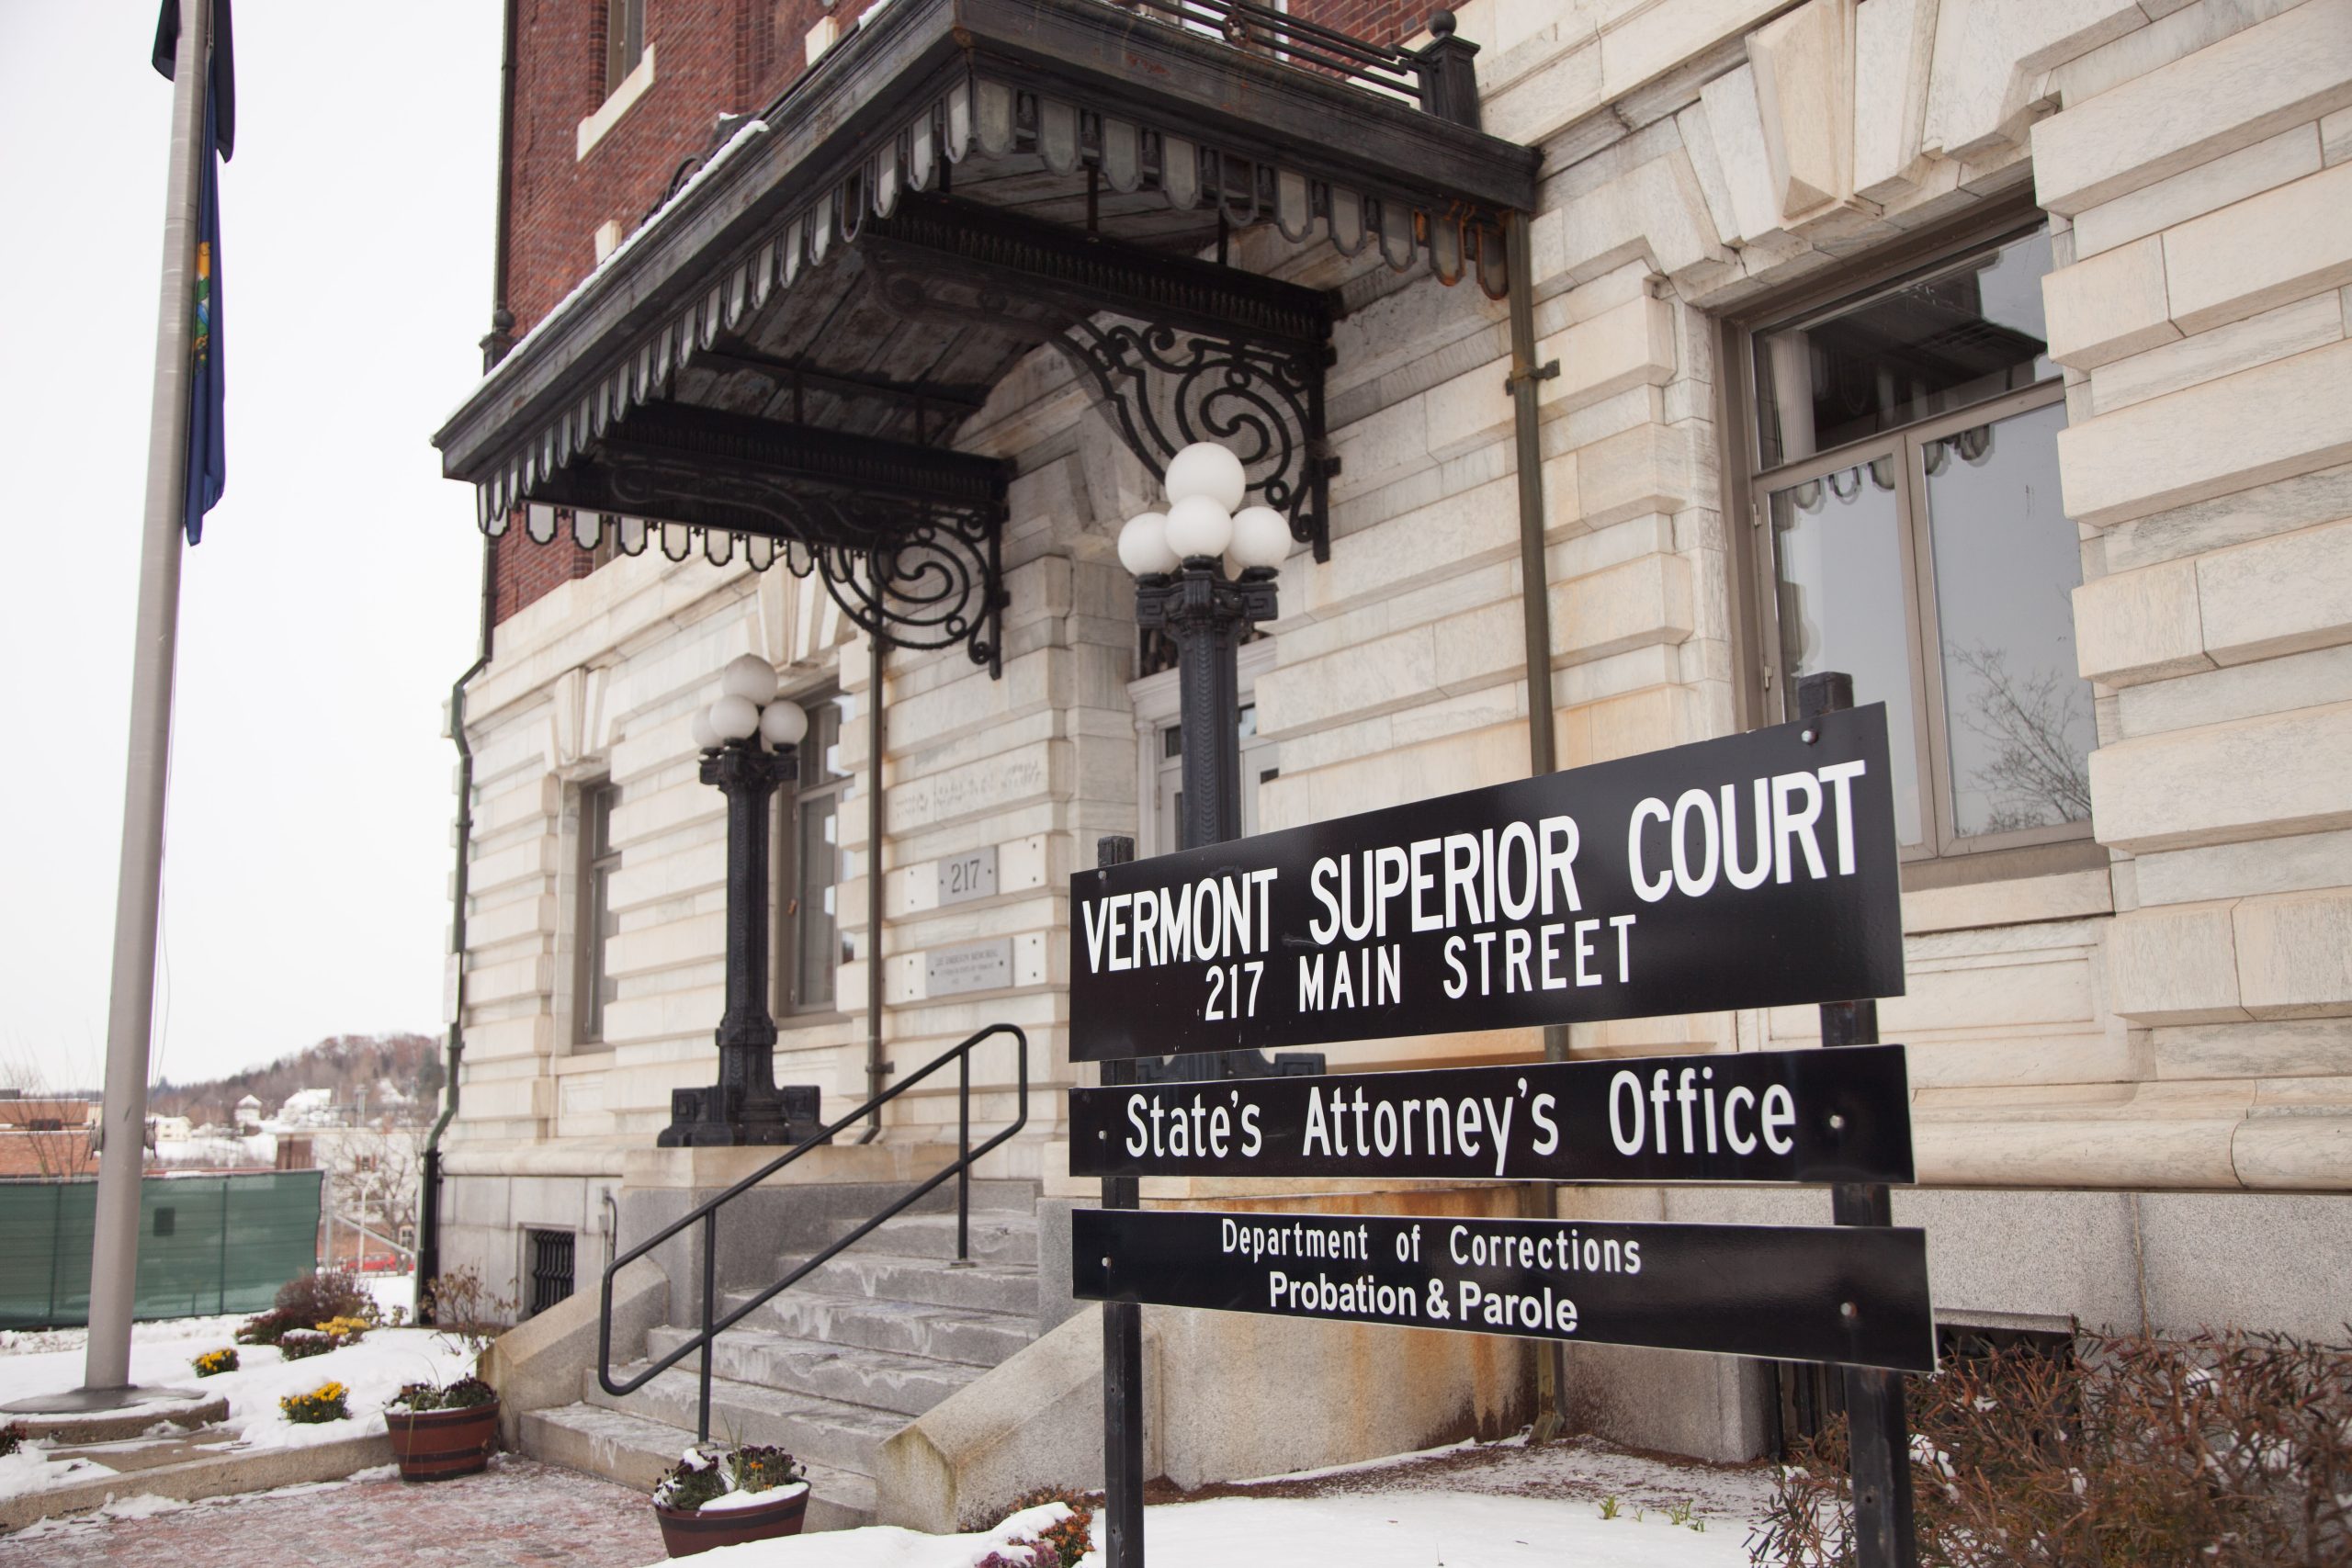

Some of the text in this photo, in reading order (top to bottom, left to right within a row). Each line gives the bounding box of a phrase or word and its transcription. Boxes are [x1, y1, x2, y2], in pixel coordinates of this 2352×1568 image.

[951, 859, 980, 893] 217
[1081, 759, 1866, 974] VERMONT SUPERIOR COURT
[1204, 914, 1636, 1021] 217 MAIN STREET
[1125, 1066, 1796, 1177] State's Attorney's Office
[1222, 1218, 1641, 1274] Department of Corrections
[1270, 1270, 1577, 1332] Probation & Parole
